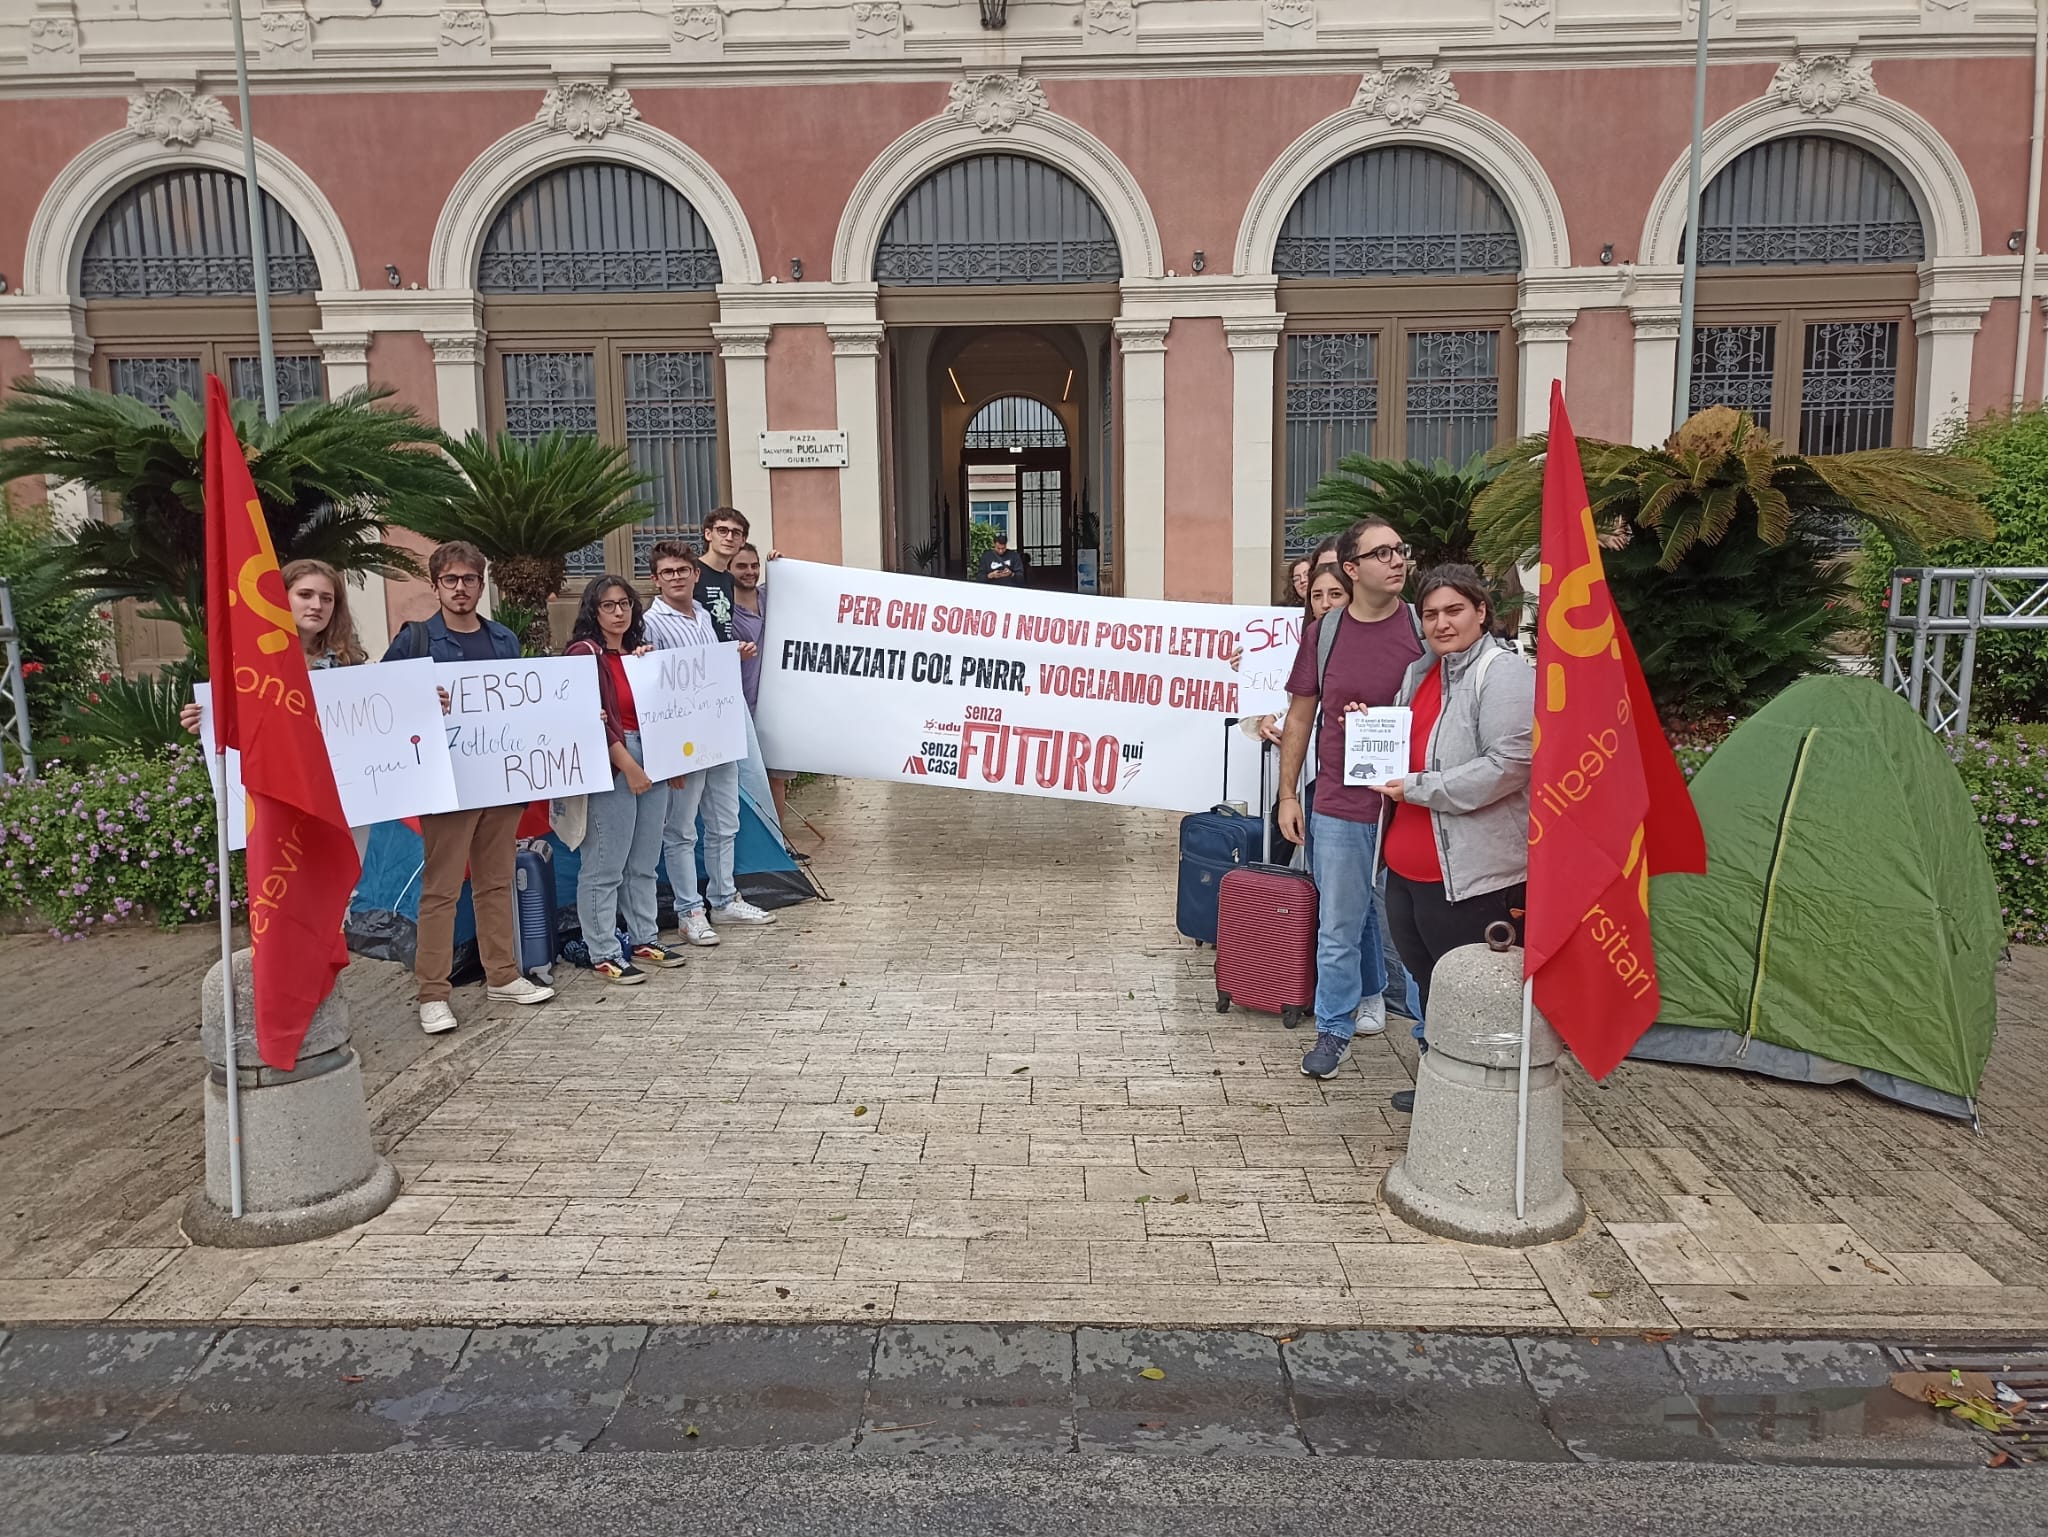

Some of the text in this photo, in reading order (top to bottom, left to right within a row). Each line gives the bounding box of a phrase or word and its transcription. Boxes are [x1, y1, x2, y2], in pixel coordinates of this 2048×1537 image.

[797, 444, 843, 454] PUGLIATTI
[838, 594, 881, 626] PER
[886, 599, 927, 631] CHI
[931, 605, 997, 637] SONO
[1002, 613, 1011, 639] I
[1016, 614, 1090, 646] NUOVI
[1095, 622, 1163, 653] POSTI
[1245, 616, 1305, 653] SEN
[660, 648, 706, 691] NON
[781, 639, 906, 680] FINANZIATI
[911, 651, 953, 685] COL
[960, 656, 1031, 695] PNRR,
[1040, 664, 1163, 706] VOGLIAMO
[1242, 668, 1291, 692] SENZ
[964, 704, 1002, 722] senza
[938, 722, 961, 732] udu
[537, 733, 552, 746] a
[920, 740, 957, 758] senza
[1361, 740, 1395, 752] FUTURO
[957, 721, 1120, 795] FUTURO
[1122, 741, 1144, 762] qui
[504, 742, 583, 792] ROMA
[927, 757, 957, 776] casa
[364, 761, 407, 797] qui
